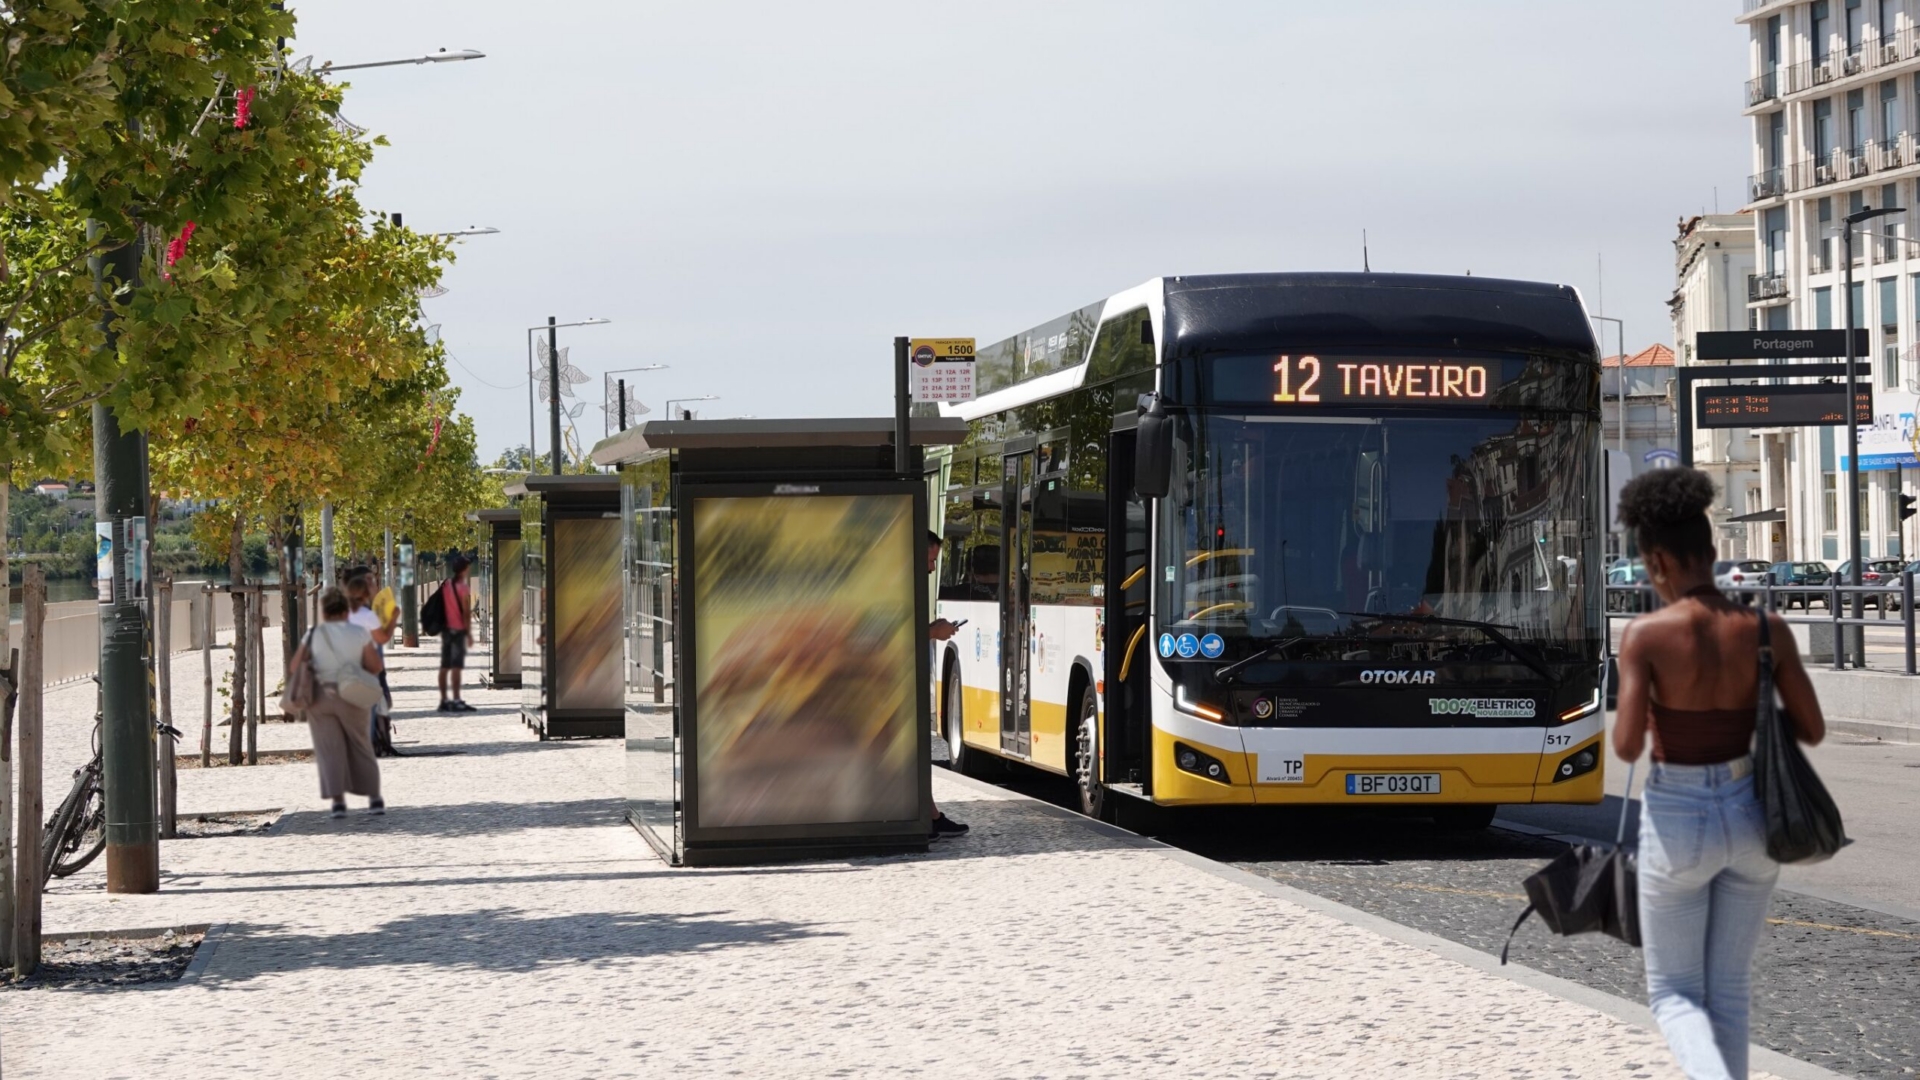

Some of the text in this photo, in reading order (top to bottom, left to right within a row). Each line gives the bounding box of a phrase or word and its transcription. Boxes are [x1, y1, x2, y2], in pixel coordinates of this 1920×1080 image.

[947, 345, 973, 355] 1500
[1753, 339, 1814, 351] Portagem
[1273, 355, 1486, 402] 12 TAVEIRO
[1360, 670, 1436, 684] OTOKAR
[1430, 699, 1535, 714] 100% ELETRICO
[1546, 734, 1572, 745] 517
[1283, 760, 1303, 774] TP
[1361, 776, 1432, 792] BF 03 QT
